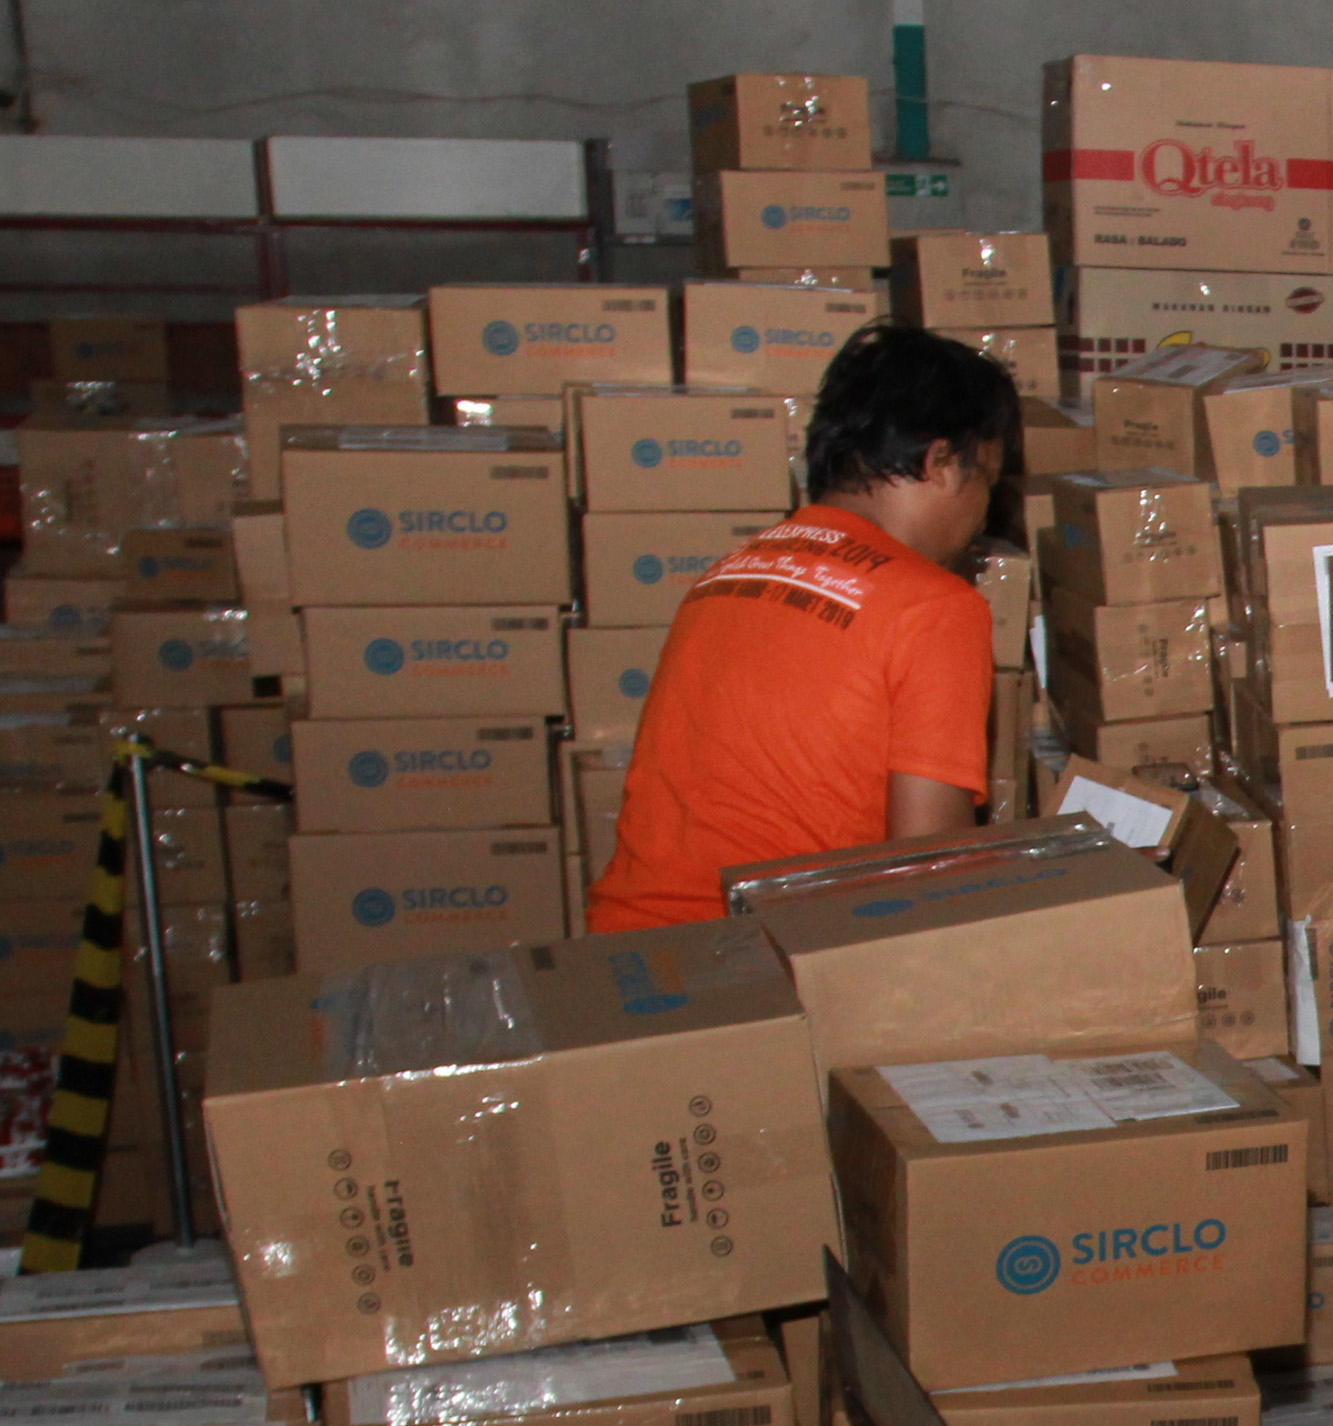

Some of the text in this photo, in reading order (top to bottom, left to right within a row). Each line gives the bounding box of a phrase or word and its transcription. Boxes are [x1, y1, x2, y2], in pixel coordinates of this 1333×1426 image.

[1140, 137, 1284, 198] Qtela
[788, 206, 850, 222] SIRCLO
[524, 322, 616, 344] SIRCLO
[764, 329, 835, 347] SIRCLO
[667, 439, 743, 458] SIRCLO
[399, 510, 508, 533] SIRCLO
[828, 538, 892, 573] 2019
[815, 565, 866, 596] Together
[411, 639, 510, 661] SIRCLO
[393, 749, 493, 773] SIRCLO
[400, 885, 508, 909] SIRCLO
[656, 1140, 682, 1229] Fragile
[1073, 1218, 1227, 1265] SIRCLO
[1070, 1253, 1225, 1286] COMMERCE
